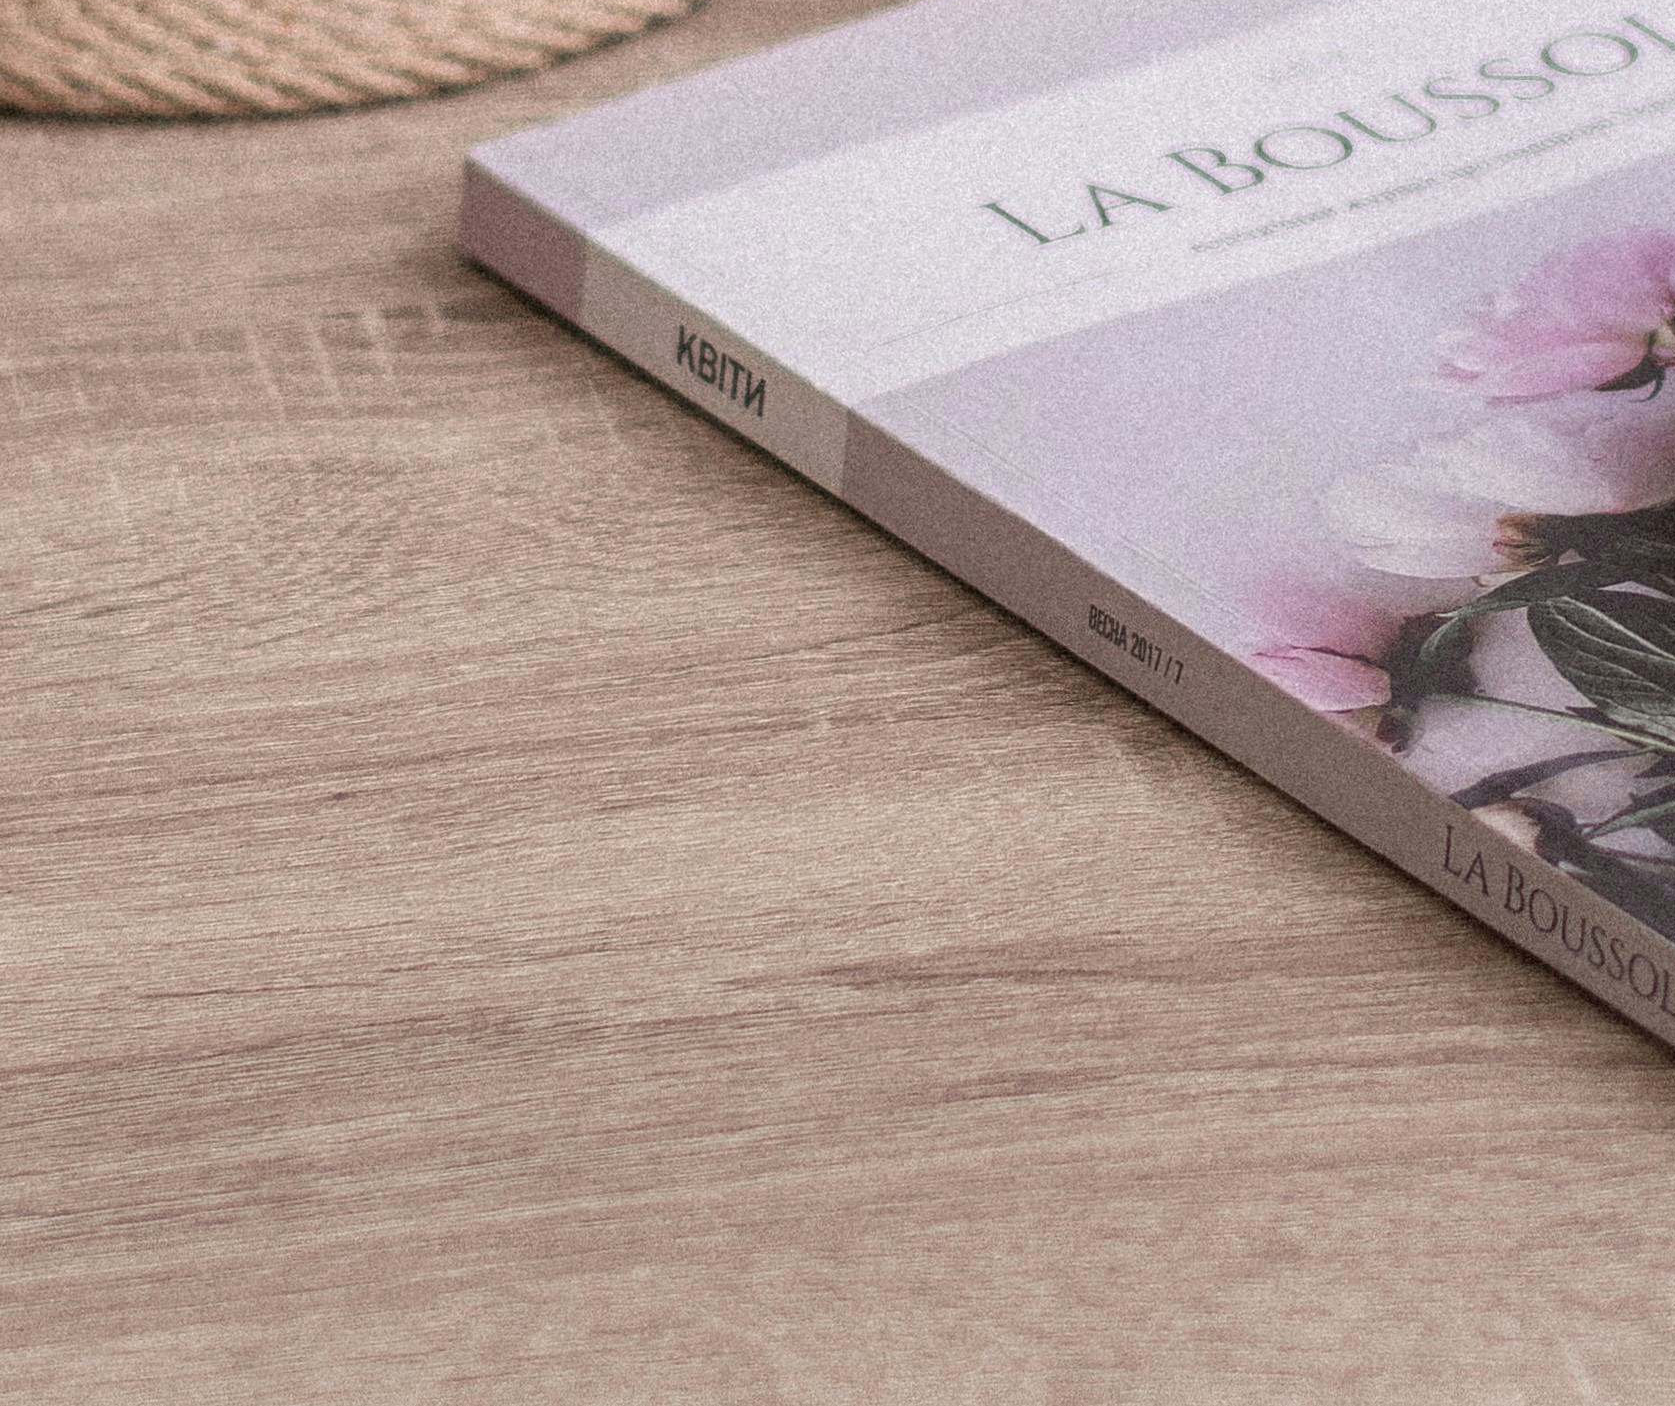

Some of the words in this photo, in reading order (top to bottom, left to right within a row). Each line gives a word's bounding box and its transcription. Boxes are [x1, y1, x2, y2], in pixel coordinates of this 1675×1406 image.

[981, 182, 1176, 245] LA
[675, 323, 767, 418] КВІТИ
[1088, 603, 1128, 652] ВЕСНА
[1130, 632, 1162, 672] 2017
[1443, 824, 1490, 897] LA
